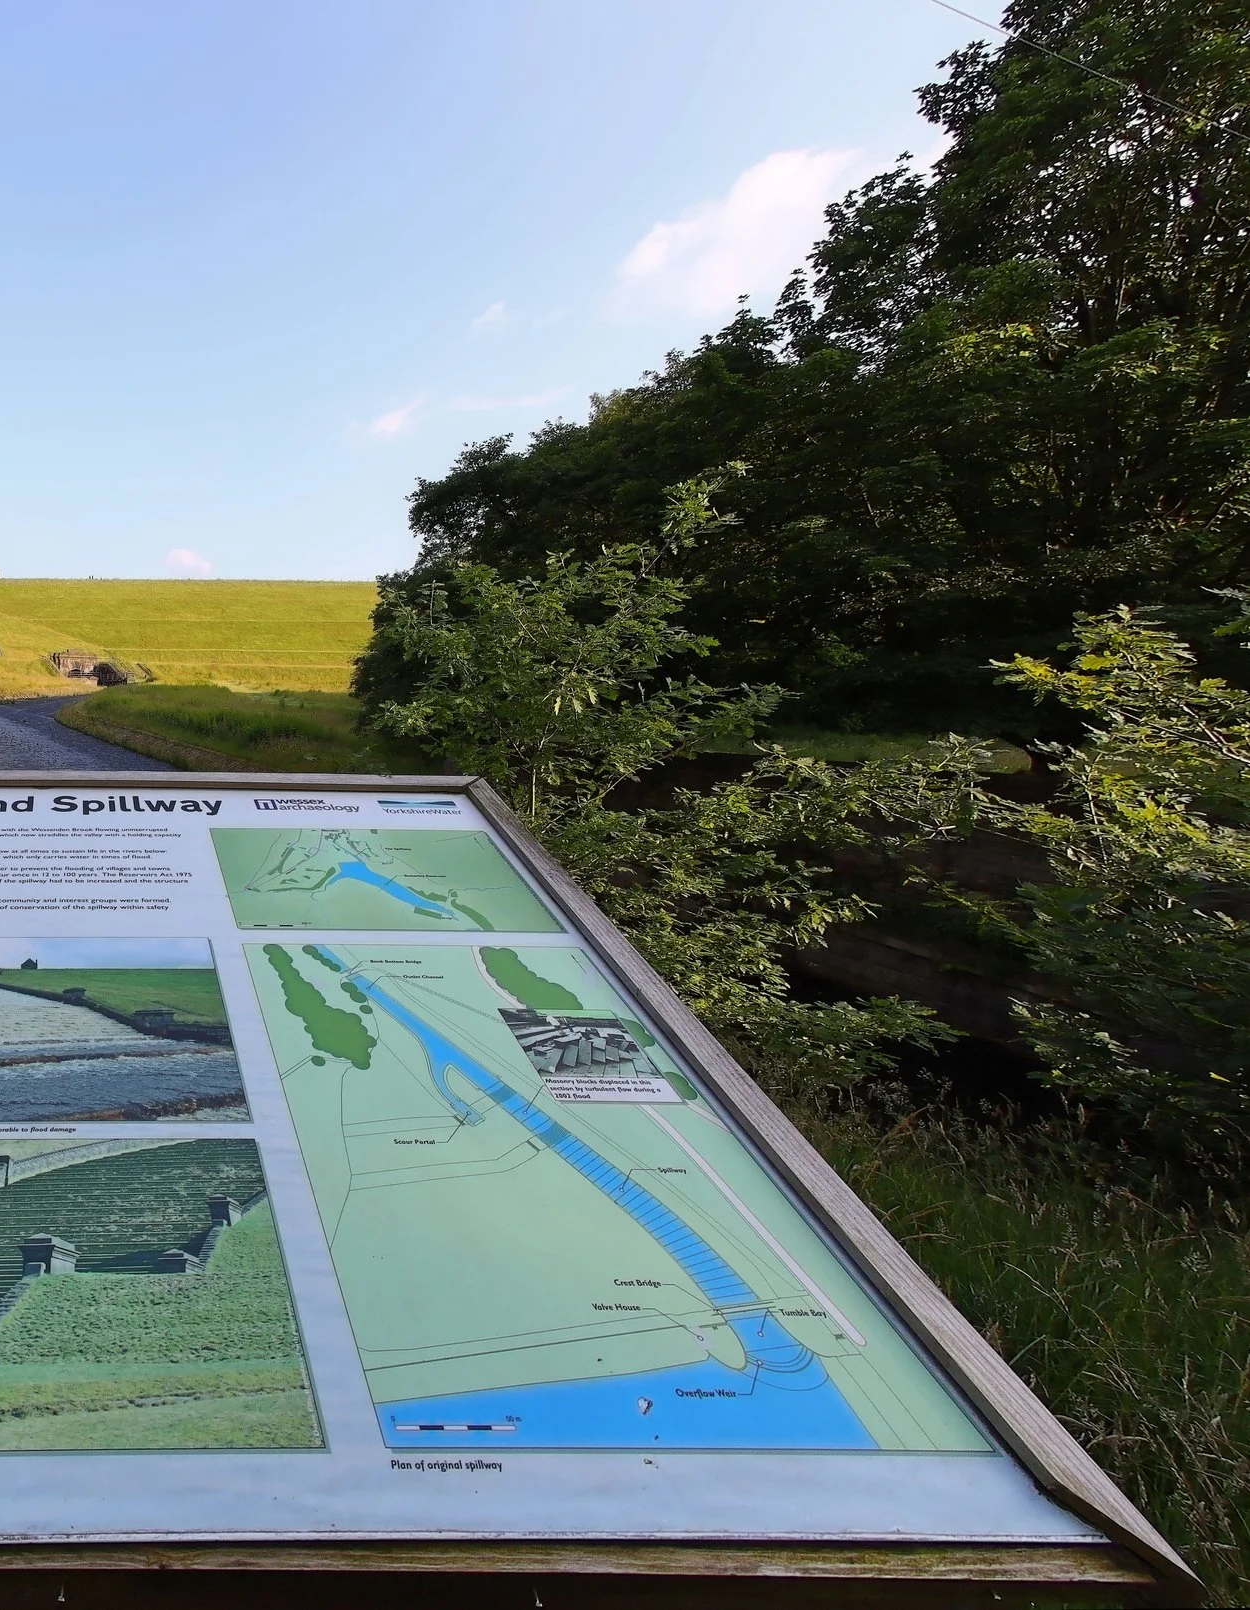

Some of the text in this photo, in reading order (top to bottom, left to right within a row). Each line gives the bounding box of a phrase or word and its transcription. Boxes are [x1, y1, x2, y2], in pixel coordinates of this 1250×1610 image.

[50, 796, 222, 816] Spillway
[278, 803, 360, 813] archaeology
[636, 1280, 662, 1288] Bridge
[779, 1309, 827, 1319] Tumble Bay
[675, 1388, 715, 1399] Overflow
[391, 1460, 502, 1472] Plan of original spillway
